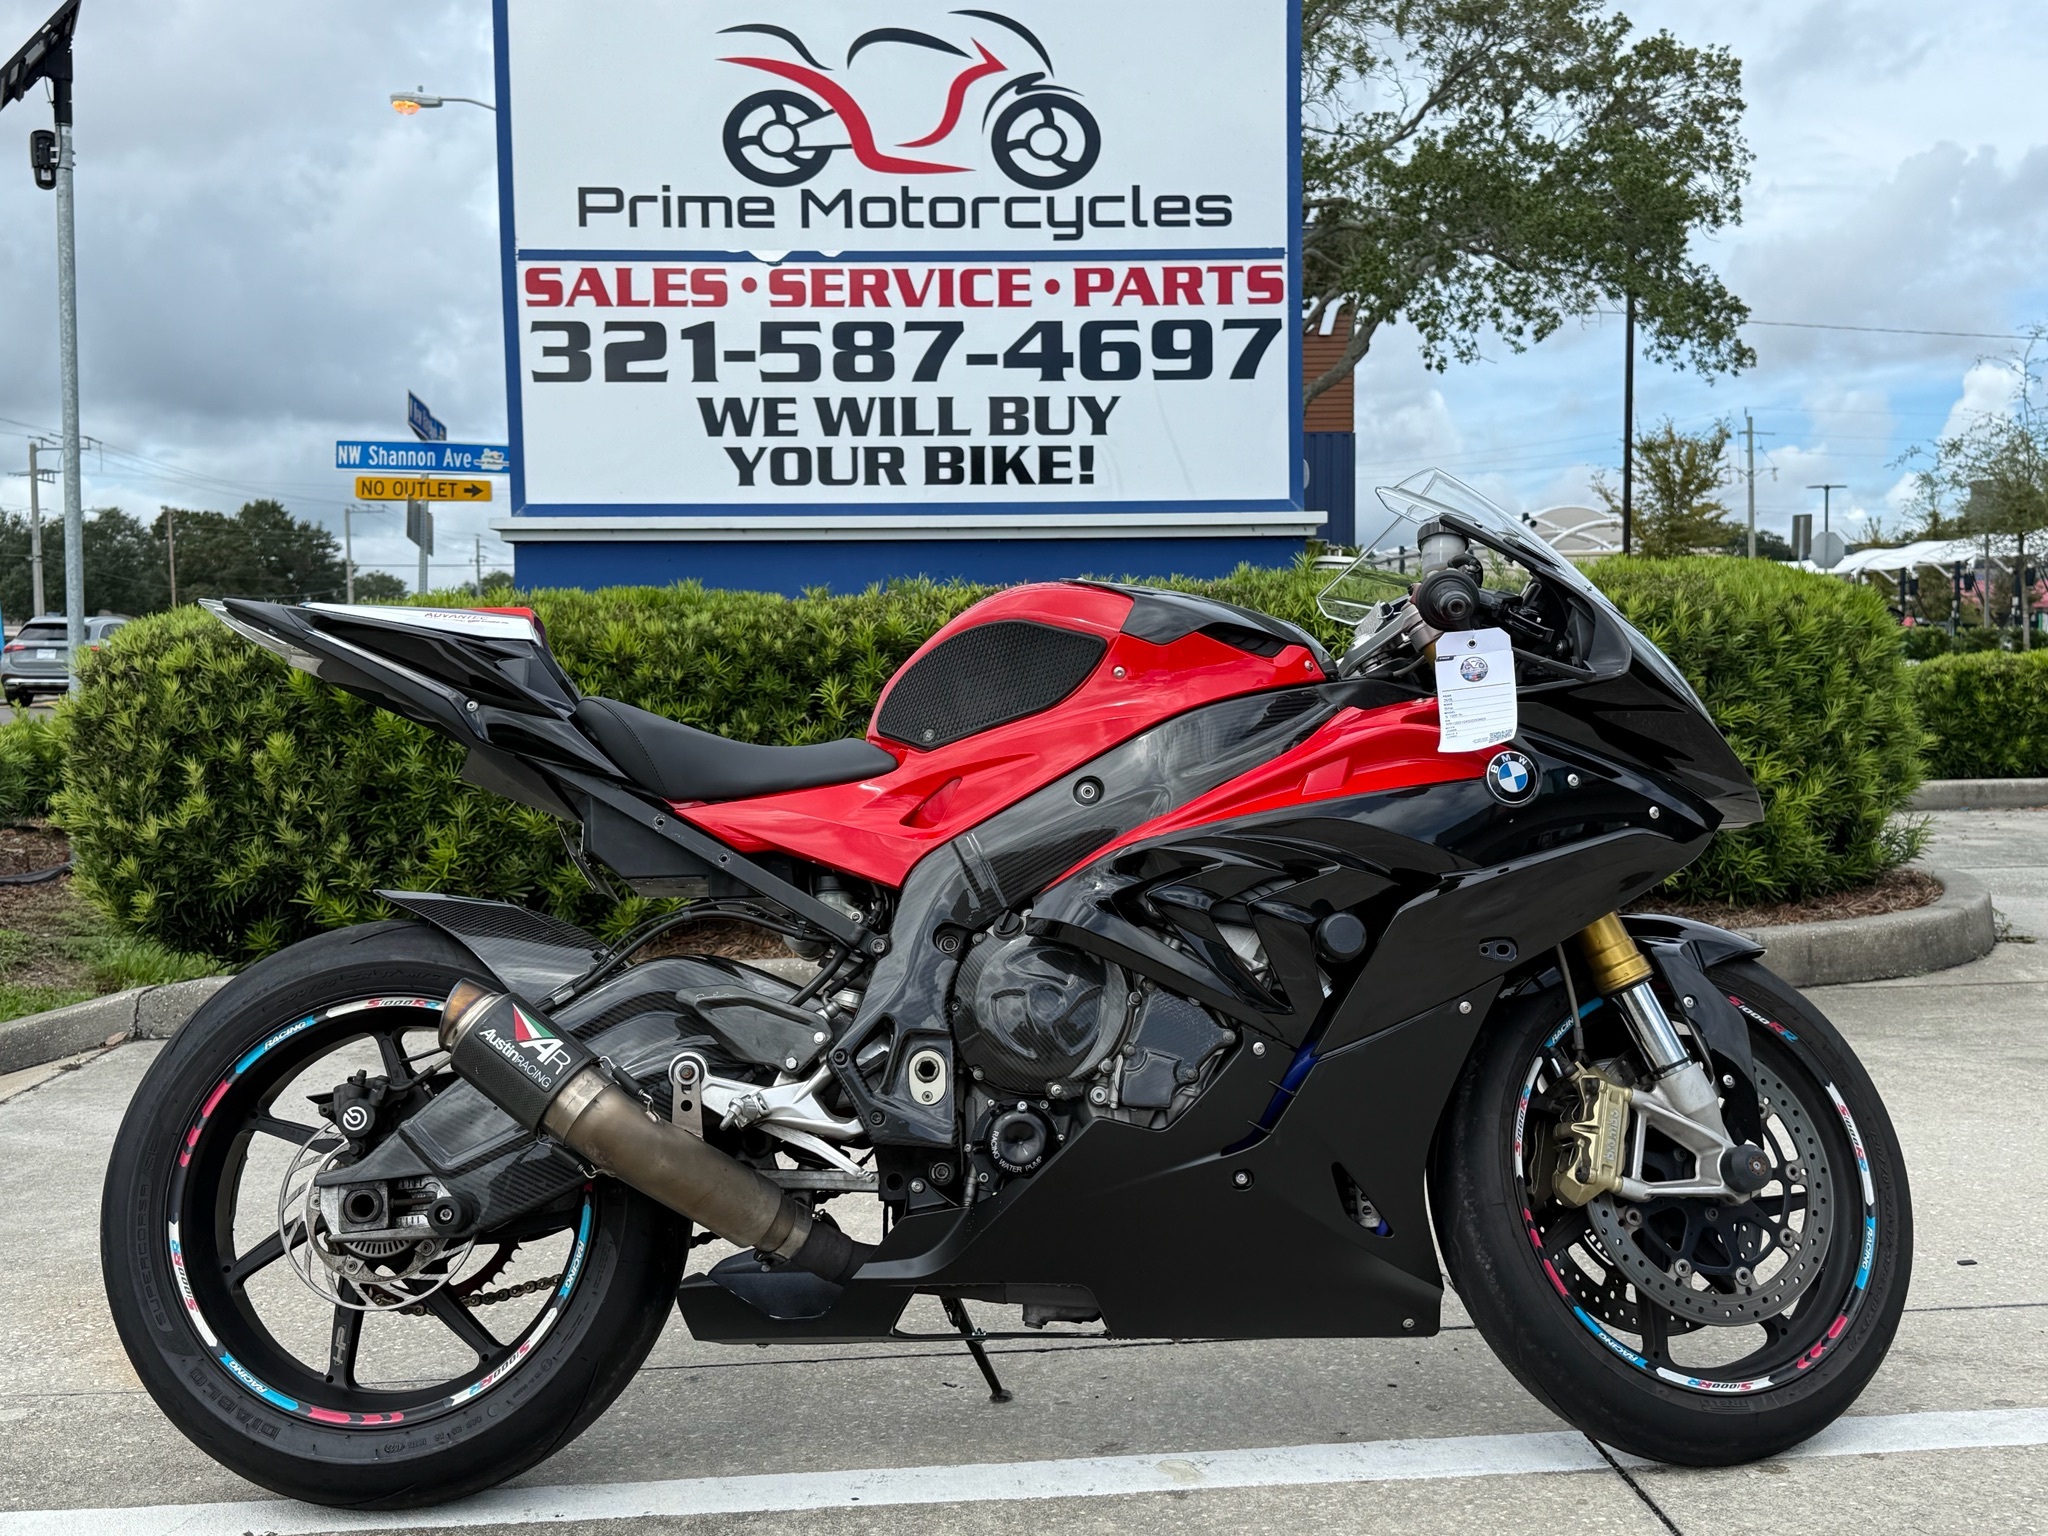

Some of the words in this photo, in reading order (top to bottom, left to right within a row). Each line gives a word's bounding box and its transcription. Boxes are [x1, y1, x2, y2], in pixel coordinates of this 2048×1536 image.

[578, 186, 775, 229] Prime
[801, 186, 1234, 242] Motorcycles
[526, 267, 729, 308] SALES
[769, 267, 1033, 308] SERVICE
[1074, 264, 1285, 307] PARTS
[530, 318, 1284, 384] 321-587-4697
[697, 396, 800, 438] WE
[814, 396, 973, 438] WILL
[988, 395, 1121, 437] BUY
[337, 445, 362, 465] NW
[368, 445, 436, 467] Shannon
[443, 447, 472, 468] Ave
[724, 446, 907, 488] YOUR
[924, 444, 1096, 487] BIKE!
[361, 480, 385, 497] NO
[392, 480, 458, 498] OUTLET
[1490, 754, 1529, 775] BMW
[263, 1020, 307, 1050] RACING
[998, 1158, 1023, 1173] WATER
[1024, 1155, 1042, 1172] PUMP
[564, 1239, 586, 1290] RACING
[1860, 1227, 1875, 1271] RACING
[1597, 1332, 1639, 1362] RACING
[228, 1359, 268, 1394] RACING
